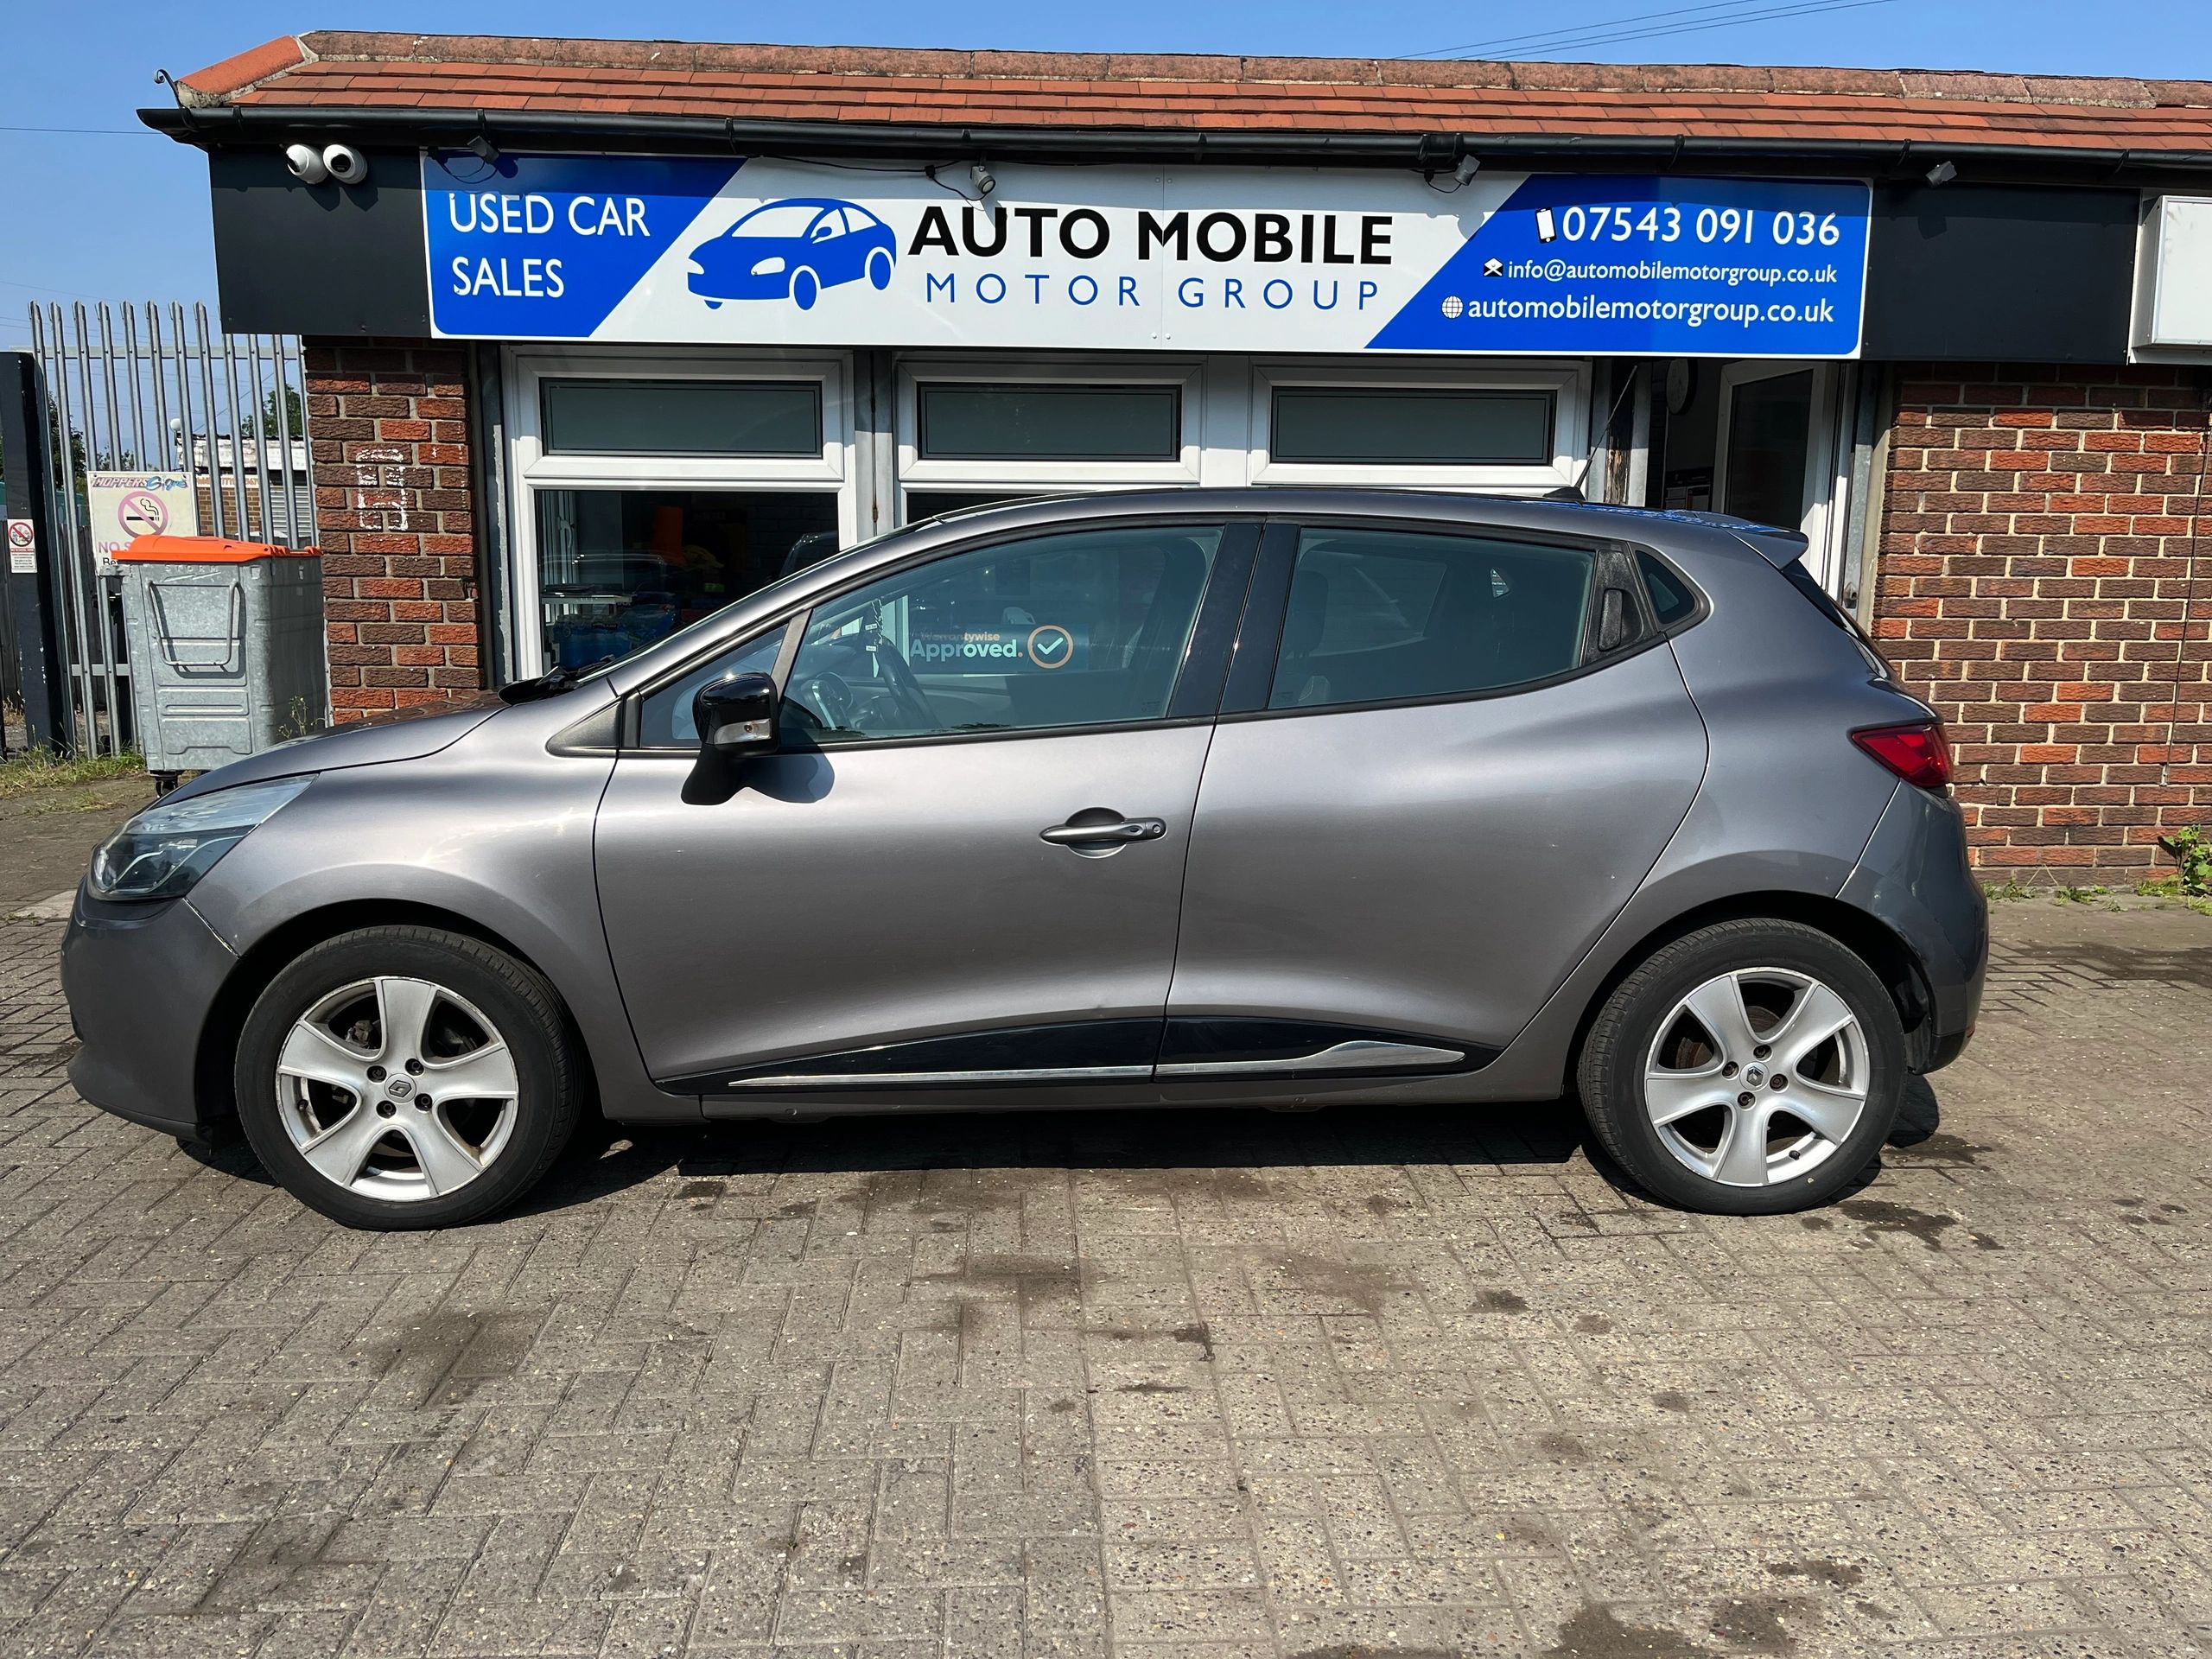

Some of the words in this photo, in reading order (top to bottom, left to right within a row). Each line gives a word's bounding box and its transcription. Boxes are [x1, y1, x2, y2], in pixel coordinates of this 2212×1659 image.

[449, 193, 554, 234] USED
[568, 195, 651, 237] CAR
[1562, 207, 1681, 243] 07543
[1695, 208, 1753, 244] 091
[1772, 210, 1840, 246] 036
[907, 206, 1110, 259] AUTO
[1137, 211, 1393, 264] MOBILE
[452, 256, 564, 298] SALES
[1508, 258, 1838, 287] info@automobilemotorgroup.co.uk
[926, 272, 1141, 307] MOTOR
[1178, 276, 1378, 310] GROUP
[1468, 294, 1834, 328] automobilemotorgroup.co.uk
[92, 476, 147, 488] HOPPERS
[98, 541, 120, 553] NO
[910, 639, 1024, 663] Approved.
